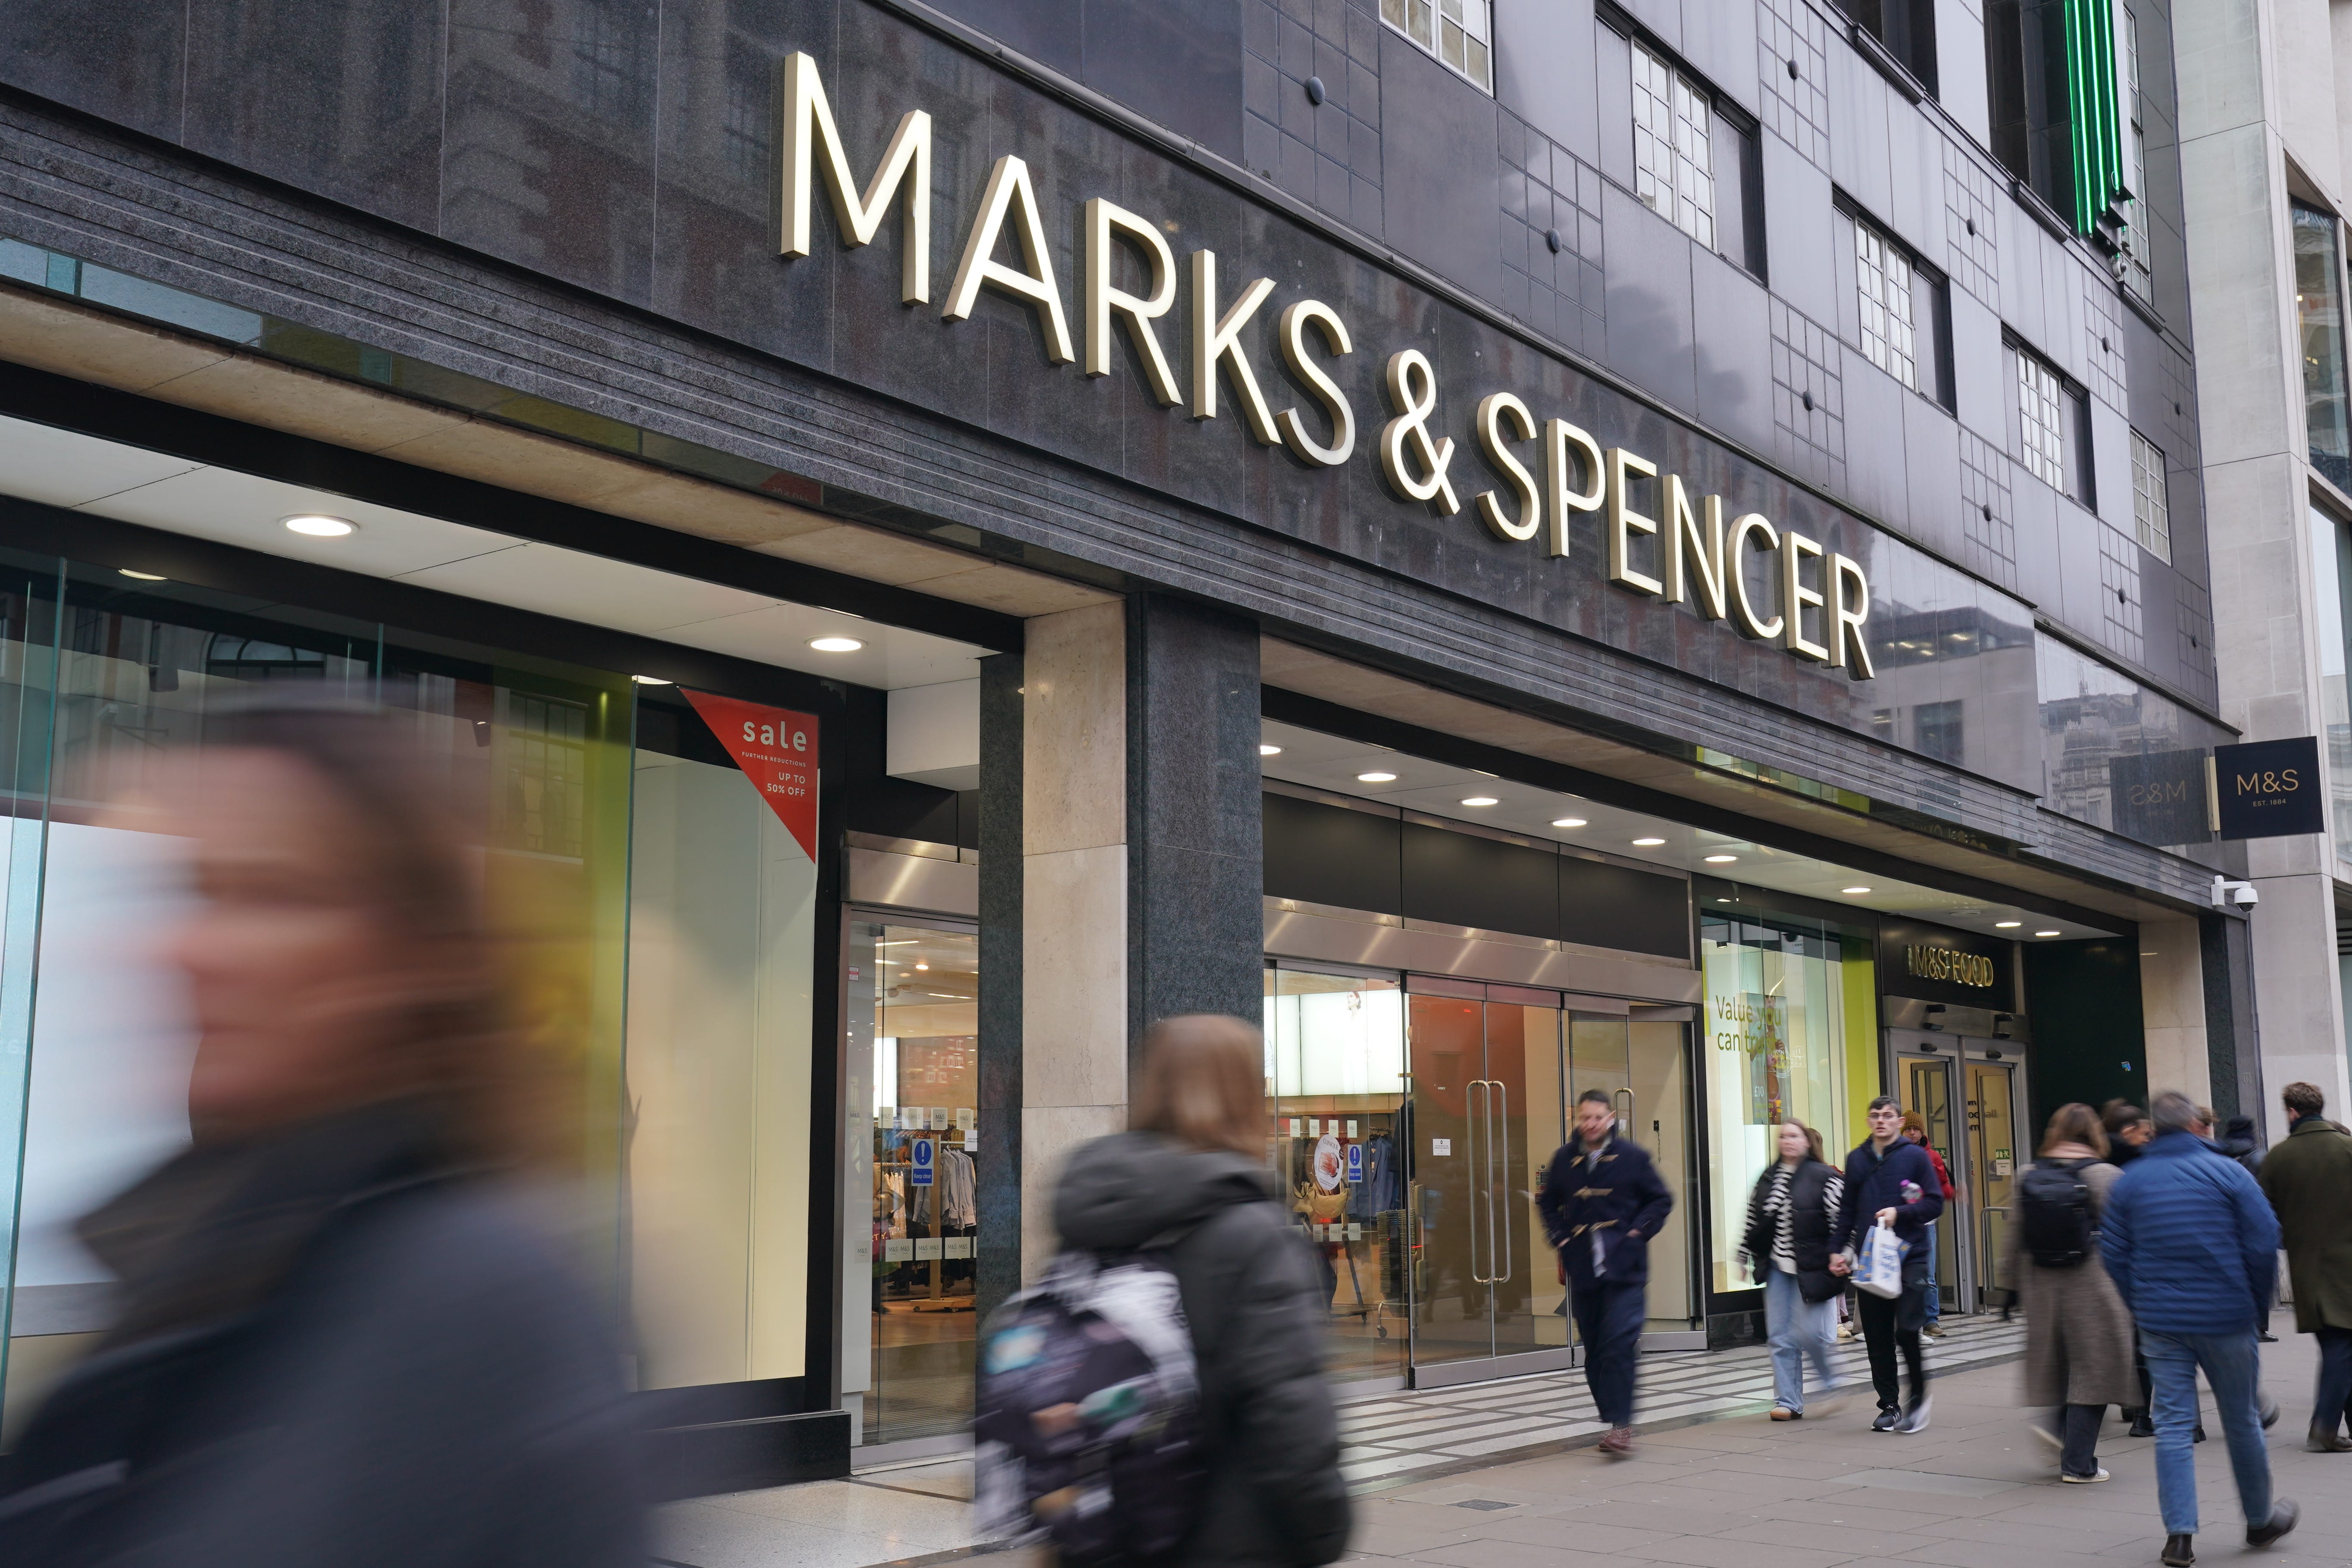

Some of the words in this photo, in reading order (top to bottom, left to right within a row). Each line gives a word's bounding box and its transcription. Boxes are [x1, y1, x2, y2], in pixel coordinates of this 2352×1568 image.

[781, 51, 1355, 467] MARKS
[1381, 349, 1460, 516] &
[1476, 392, 1874, 680] SPENCER
[743, 721, 807, 751] sale
[742, 751, 768, 761] FURTHER
[770, 757, 806, 767] REDUCTIONS
[779, 772, 791, 781] UP
[794, 775, 805, 784] TO
[2237, 769, 2299, 795] M&S
[767, 783, 785, 793] 50%
[788, 787, 805, 797] OFF
[1908, 944, 1947, 980] M&S
[1949, 950, 1993, 987] FOOD
[1716, 995, 1753, 1023] Value
[1757, 1007, 1781, 1030] you
[1717, 1032, 1740, 1051] can
[1755, 1086, 1764, 1097] £10
[1323, 1138, 1339, 1150] CLINIQUE
